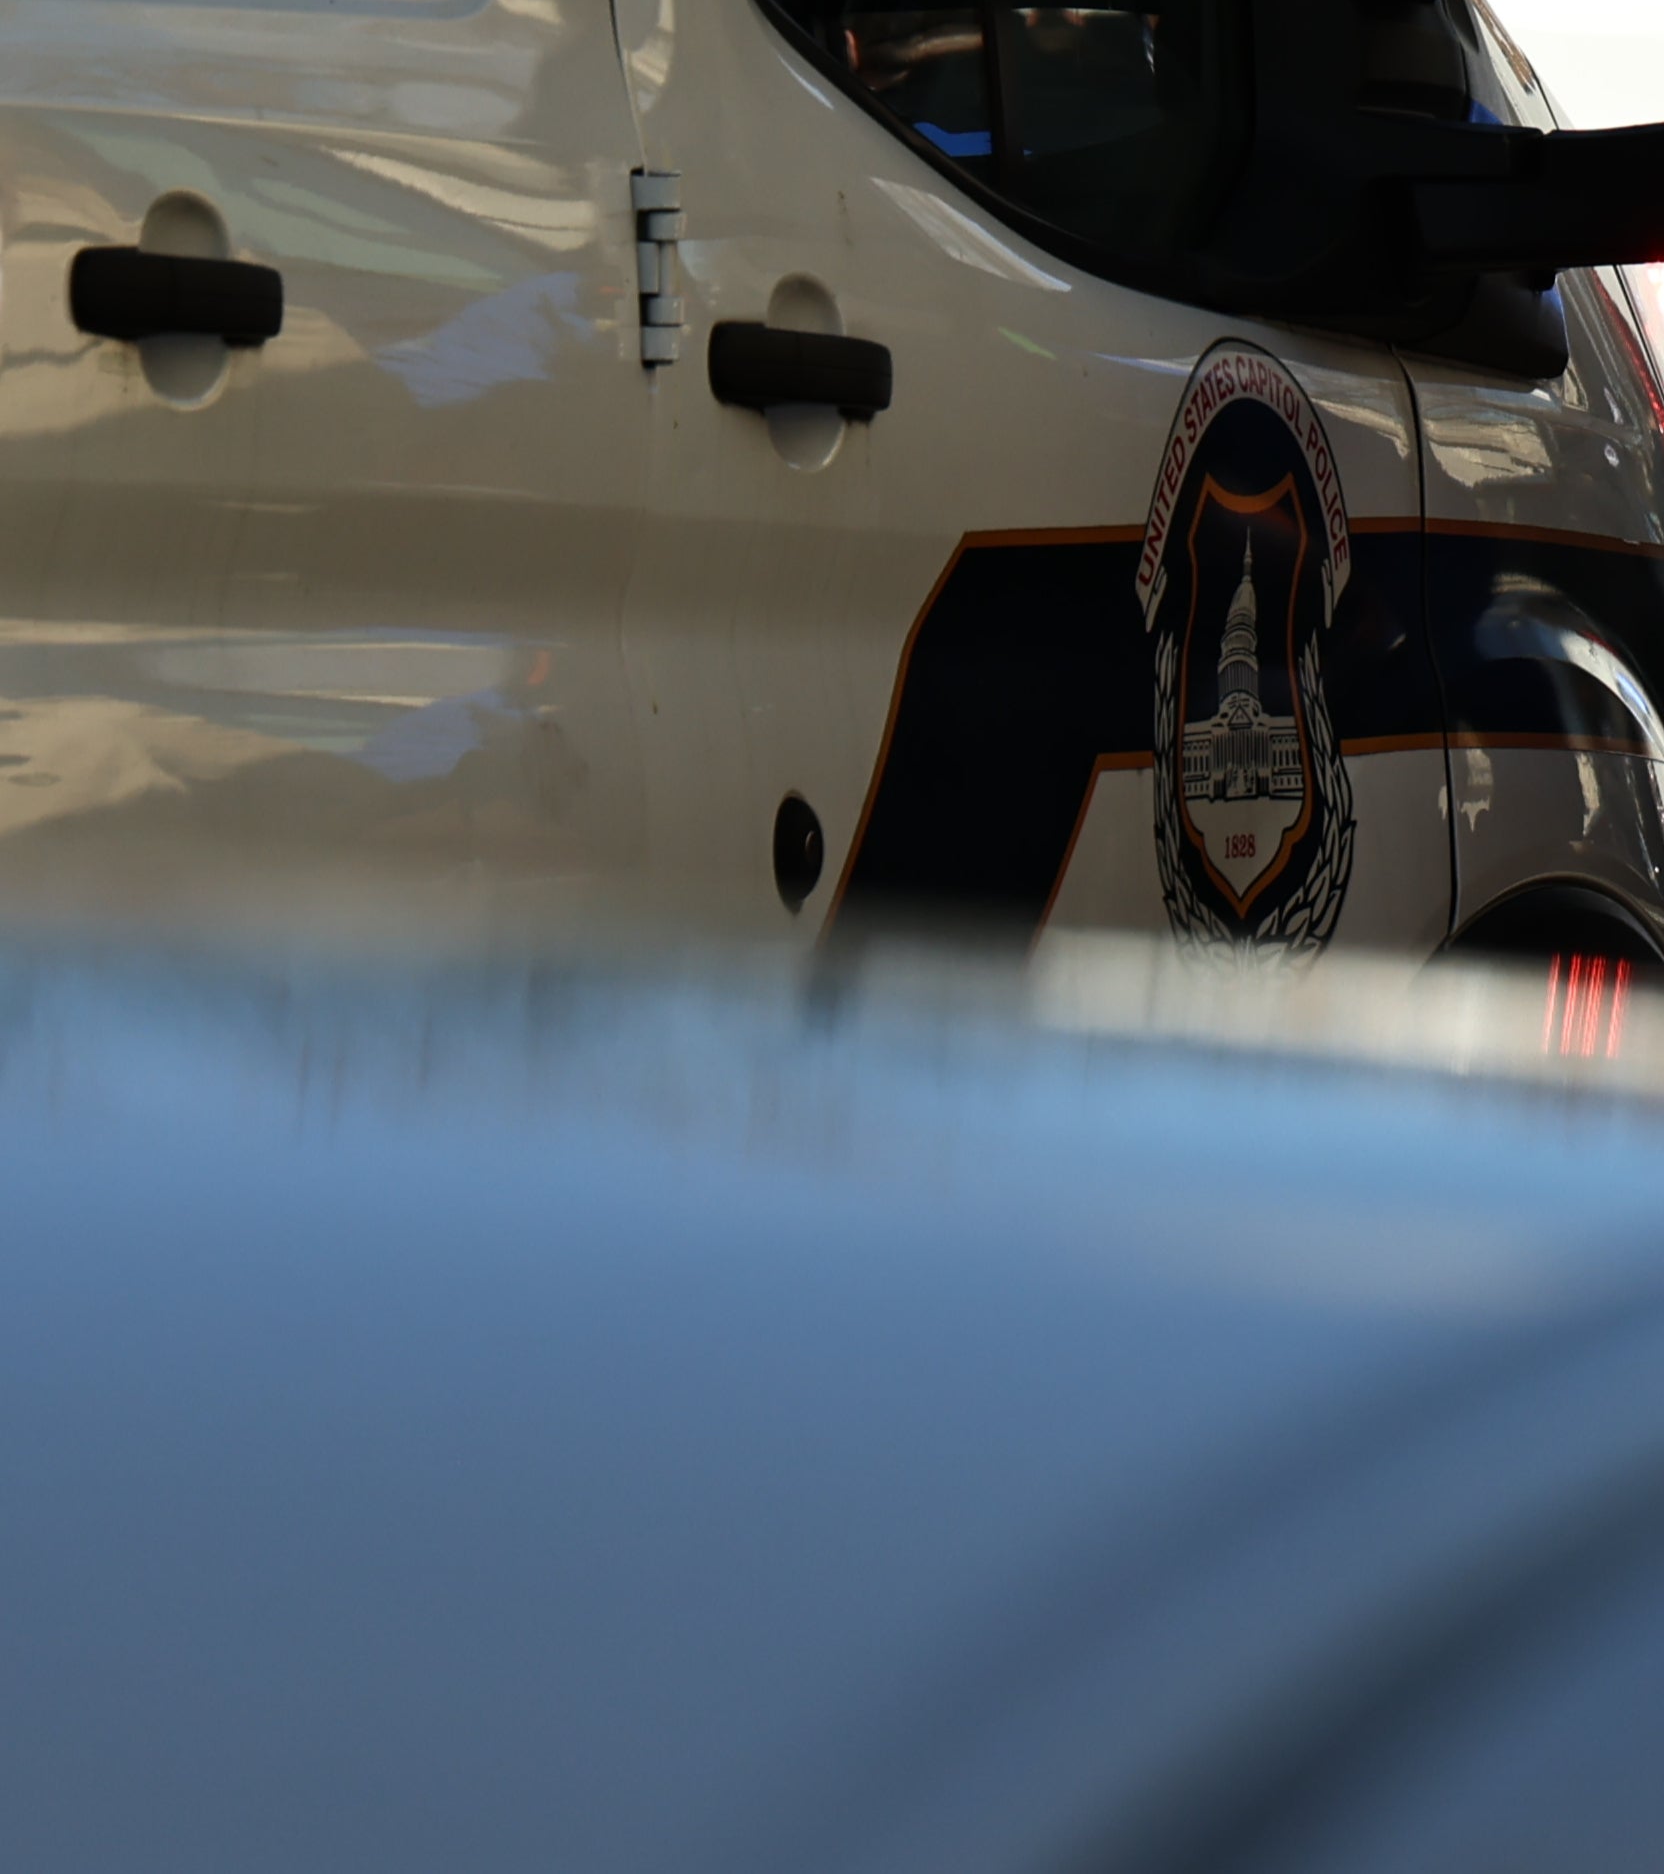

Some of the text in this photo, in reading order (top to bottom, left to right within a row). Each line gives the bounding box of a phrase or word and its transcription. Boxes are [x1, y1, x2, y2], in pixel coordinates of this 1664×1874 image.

[1139, 355, 1348, 586] UNITED STATES CAPITOL POLICE
[1225, 833, 1256, 859] 1828
